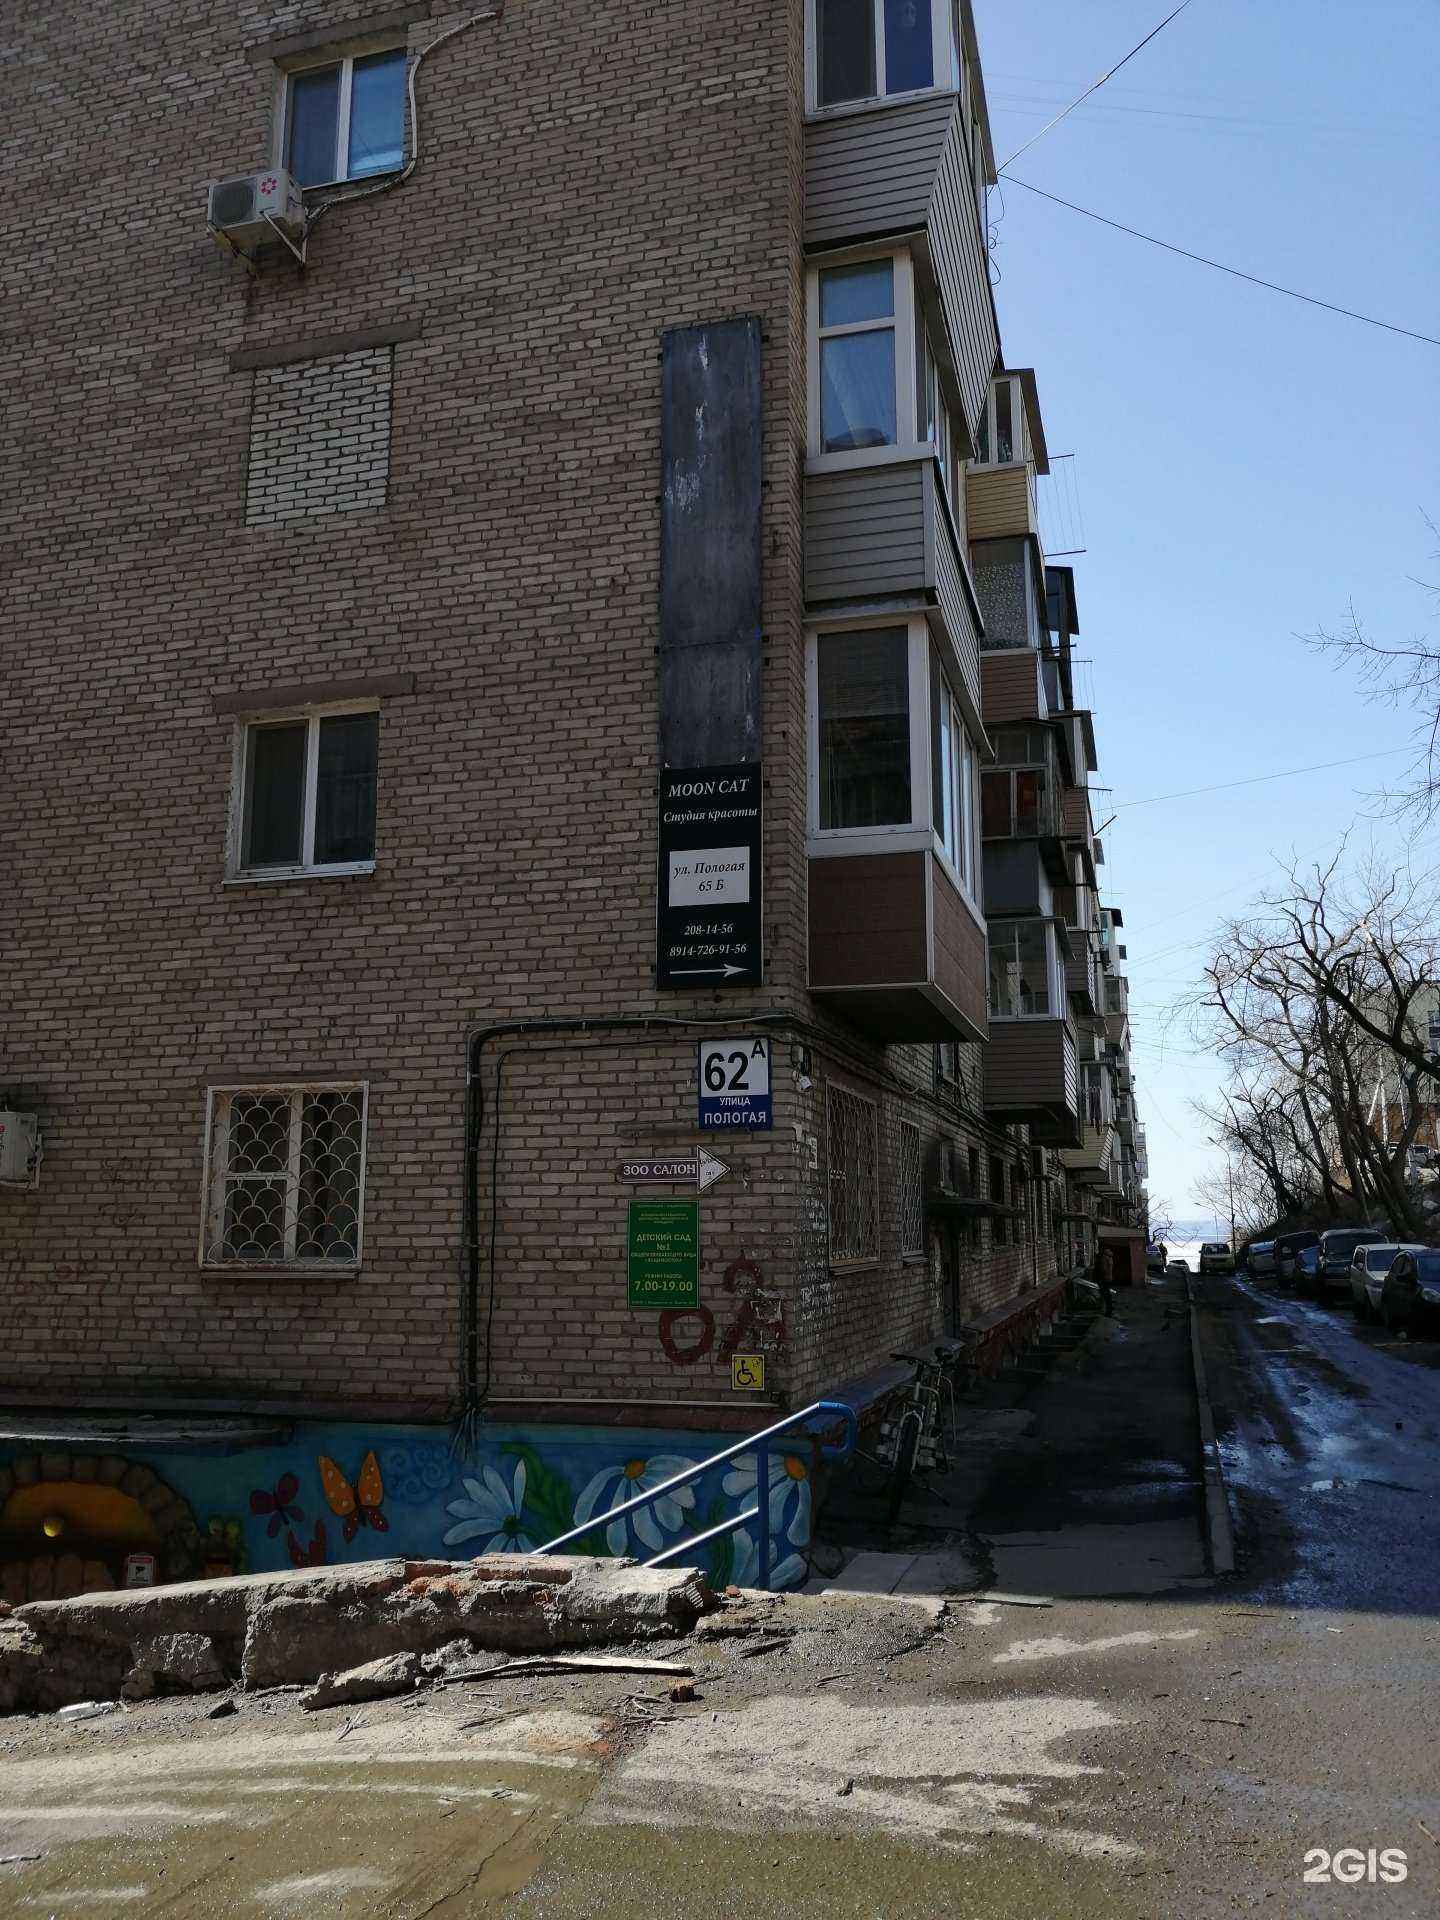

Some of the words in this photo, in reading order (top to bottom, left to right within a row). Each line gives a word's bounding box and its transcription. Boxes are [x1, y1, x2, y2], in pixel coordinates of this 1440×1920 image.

[668, 781, 715, 797] MOON
[719, 778, 750, 793] CAT
[664, 810, 705, 824] Студия
[708, 808, 757, 821] красоты
[673, 866, 691, 880] ул.
[694, 862, 746, 874] Пологая
[698, 880, 712, 892] 65
[715, 879, 725, 891] Б
[684, 923, 734, 935] 208-14-56
[669, 943, 747, 957] 8914-726-91-56
[719, 1096, 751, 1107] УЛИЦА
[704, 1111, 766, 1125] ПОЛОГАЯ
[623, 1165, 649, 1175] ЗОО
[653, 1163, 696, 1175] САЛОН
[636, 1232, 672, 1242] ДЕТСКИЙ
[673, 1233, 692, 1242] САД
[634, 1280, 694, 1292] 7.00-19.00
